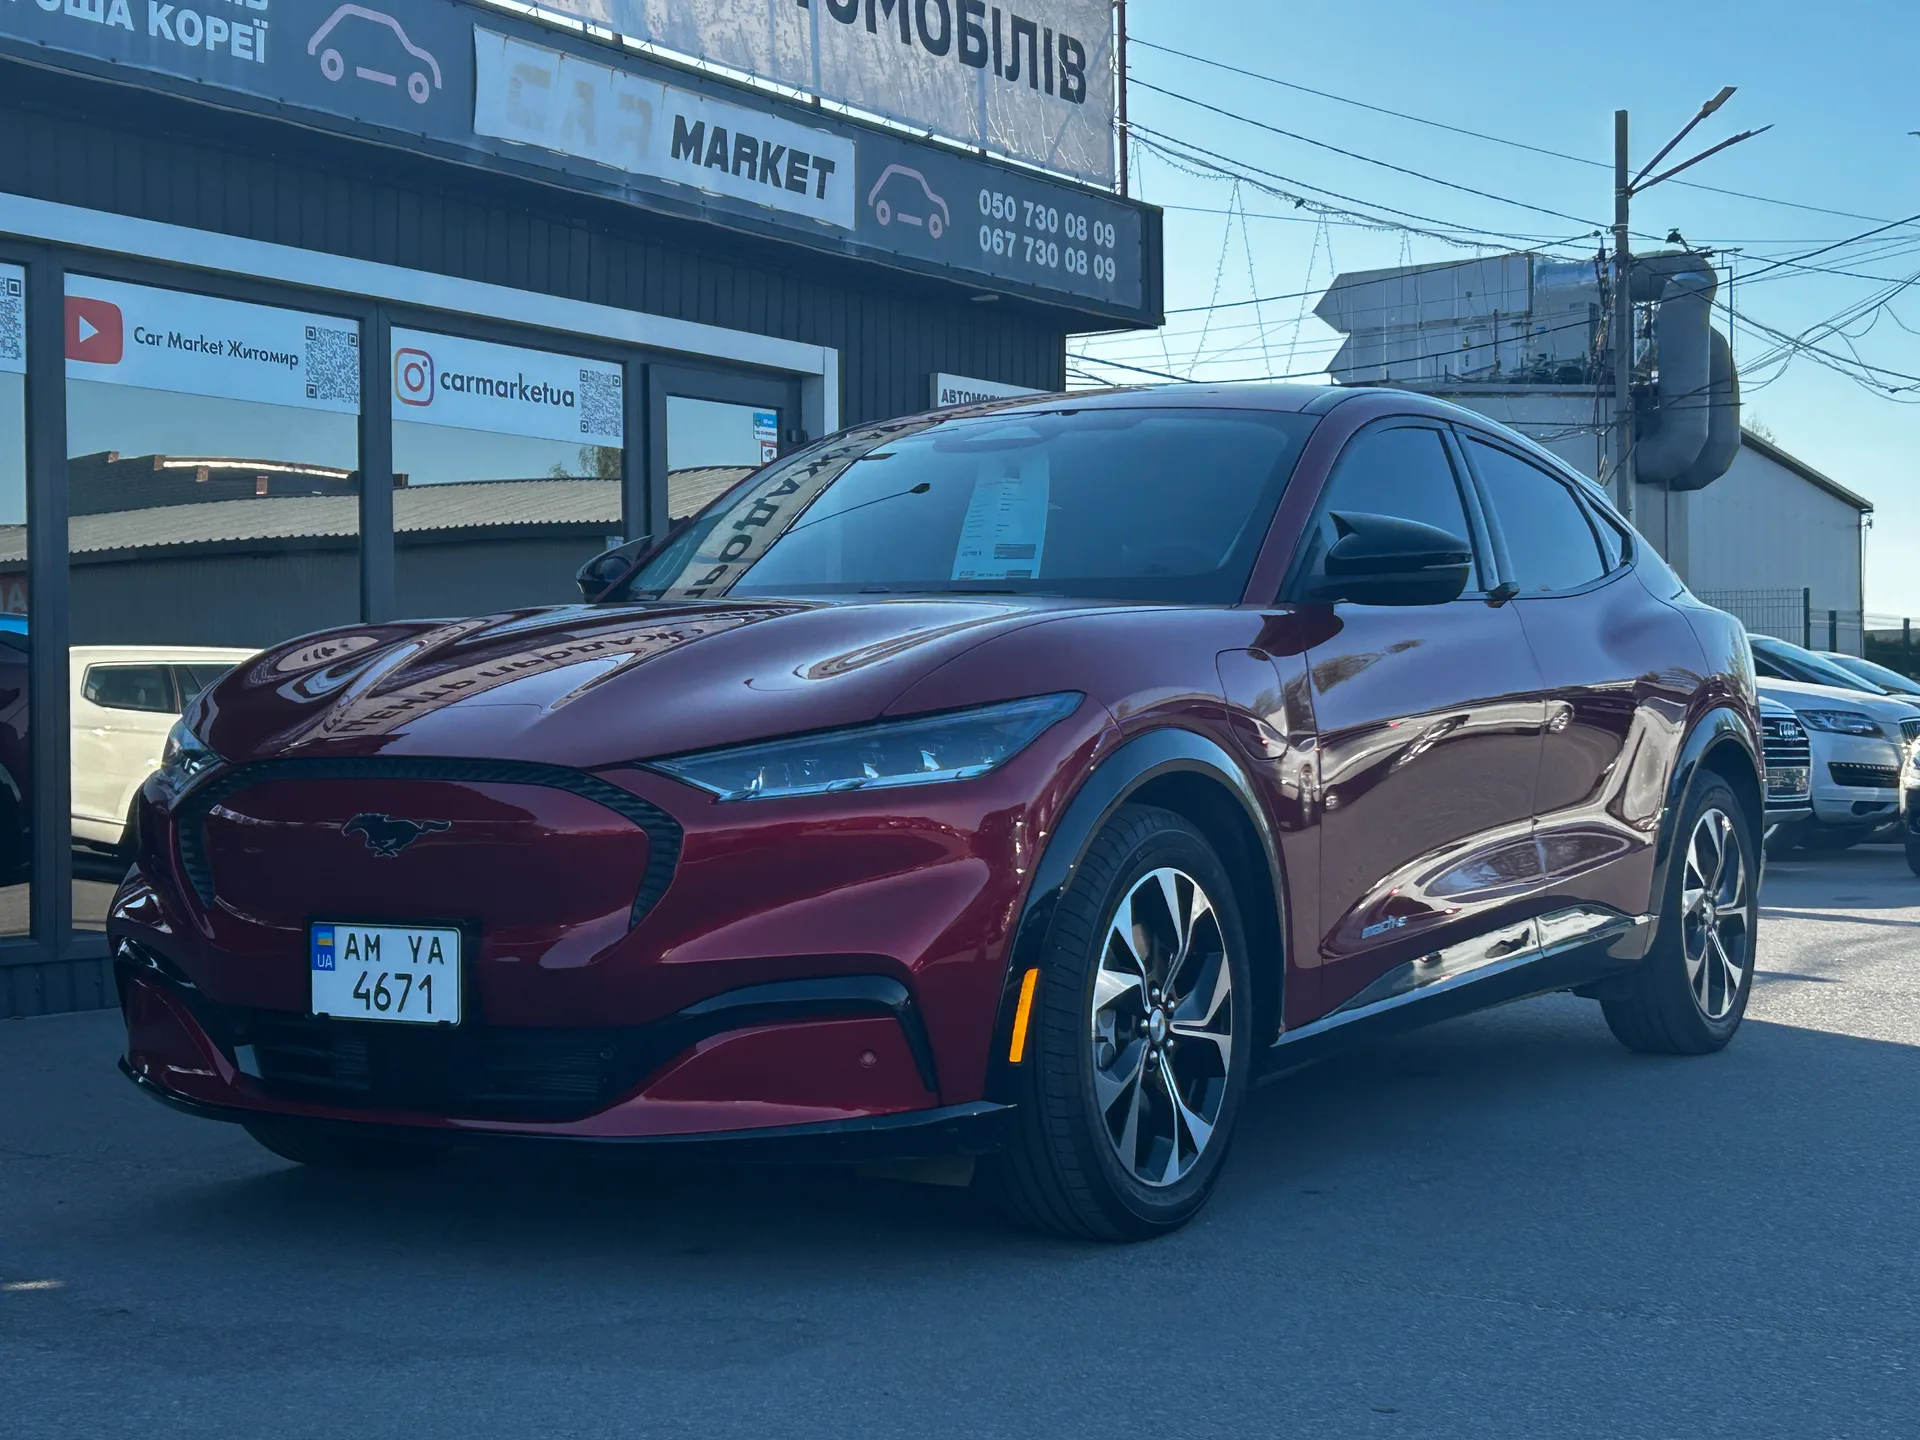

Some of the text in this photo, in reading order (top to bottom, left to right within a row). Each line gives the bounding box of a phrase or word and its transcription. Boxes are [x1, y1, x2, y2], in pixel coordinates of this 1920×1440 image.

[148, 2, 269, 63] КОРЕЇ
[670, 114, 836, 199] MARKET
[979, 188, 1116, 248] 050 730 08 09
[979, 225, 1116, 282] 067 730 08 09
[133, 326, 299, 370] Car Market Житомир
[440, 372, 575, 408] carmarketua
[317, 954, 333, 968] UA
[344, 932, 445, 965] AM YA
[353, 971, 432, 1014] 4671
